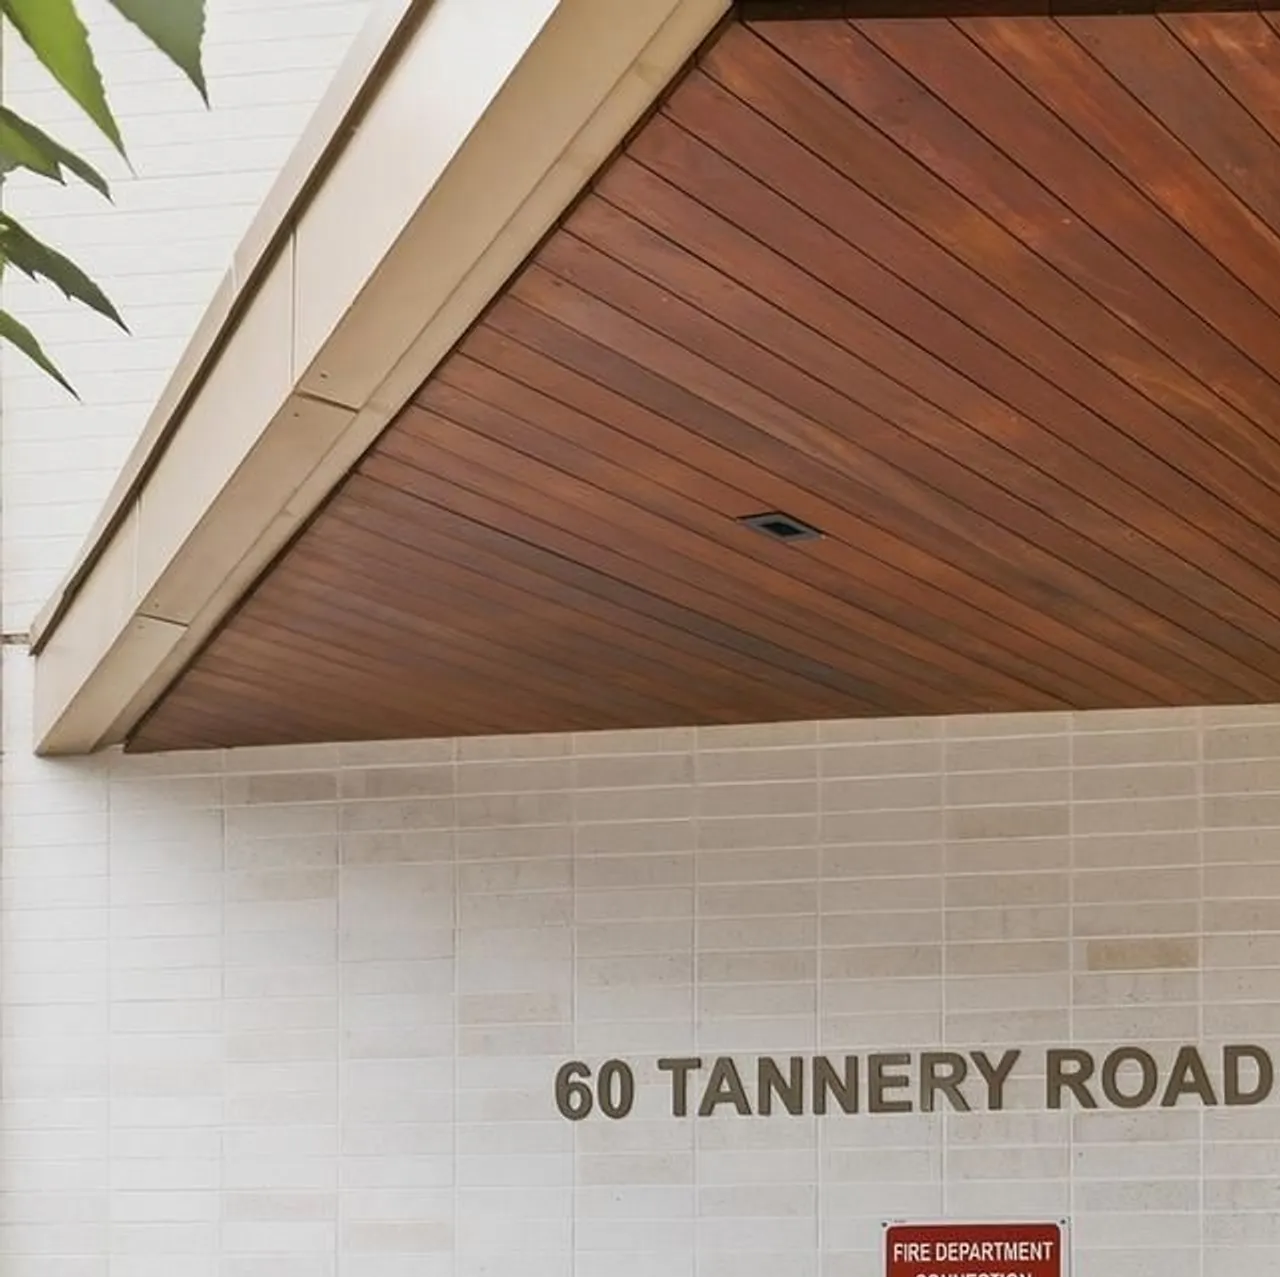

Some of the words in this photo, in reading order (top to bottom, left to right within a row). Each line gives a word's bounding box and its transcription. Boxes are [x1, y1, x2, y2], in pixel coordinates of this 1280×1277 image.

[554, 1059, 635, 1121] 60
[658, 1049, 1020, 1117] TANNERY
[1046, 1044, 1275, 1110] ROAD
[893, 1242, 932, 1262] FIRE
[936, 1241, 1053, 1262] DEPARTMENT
